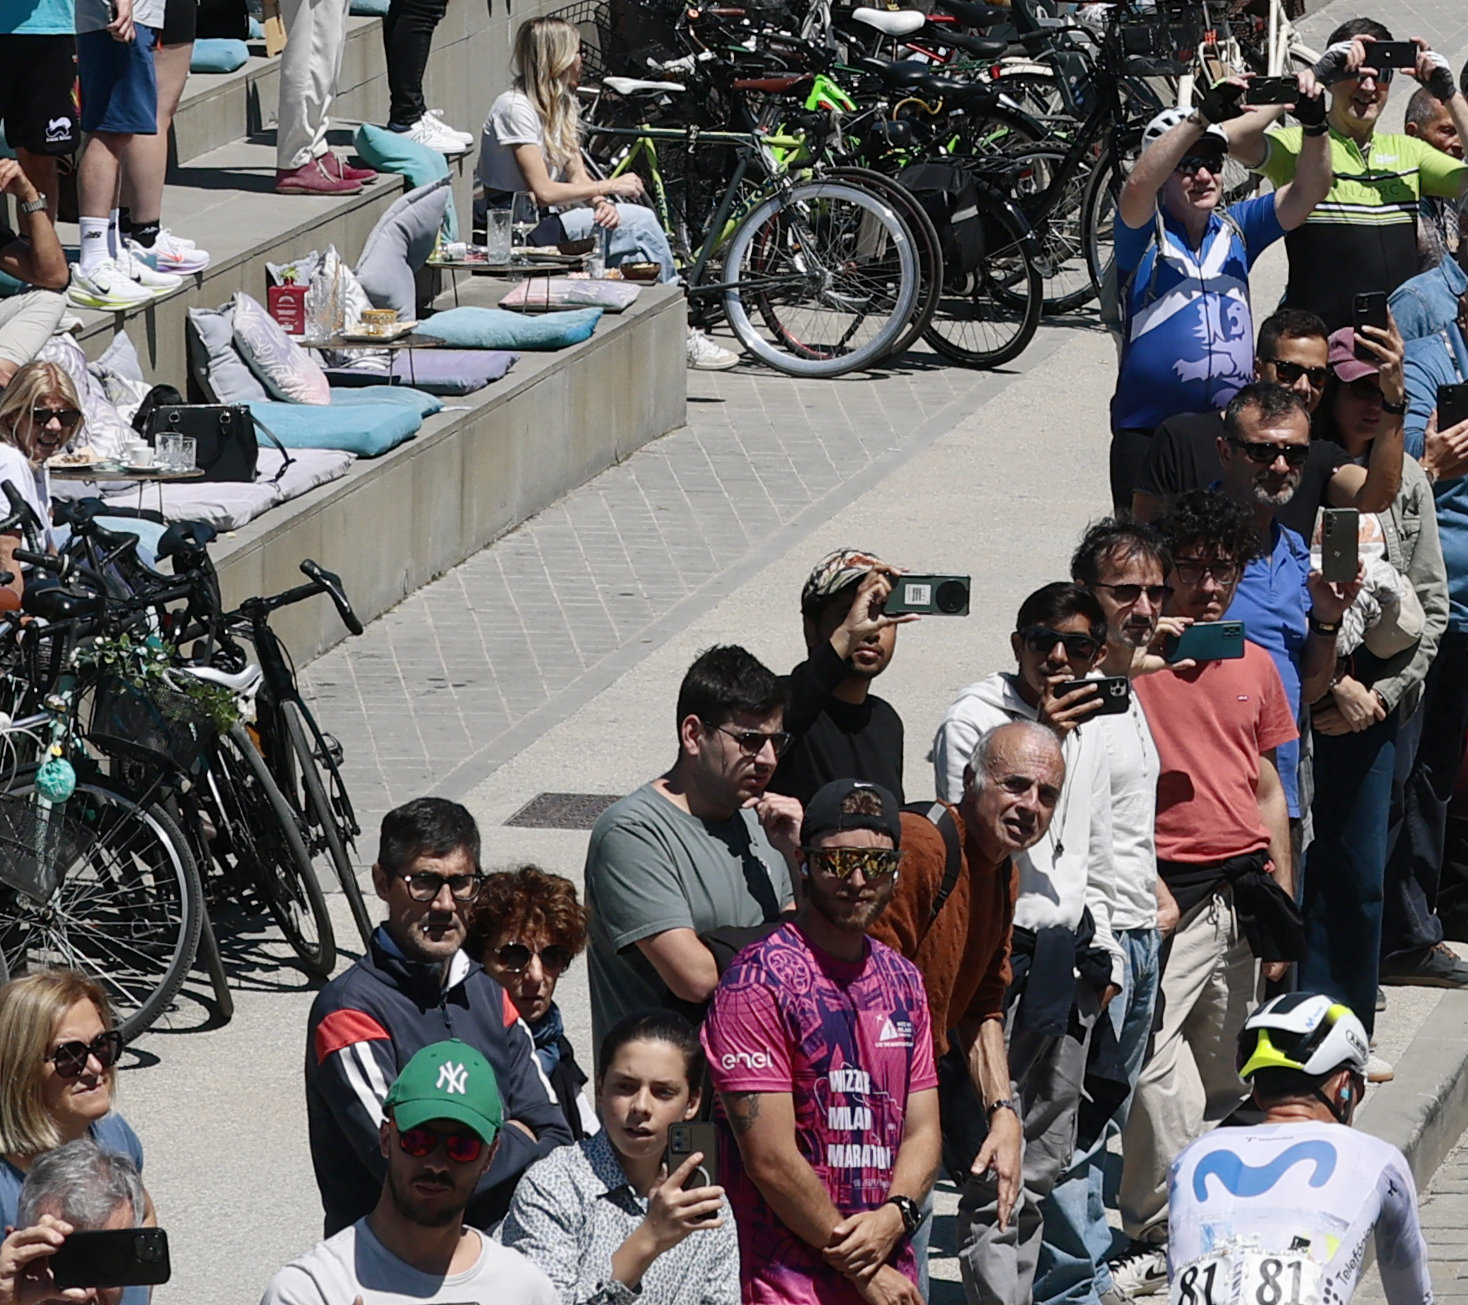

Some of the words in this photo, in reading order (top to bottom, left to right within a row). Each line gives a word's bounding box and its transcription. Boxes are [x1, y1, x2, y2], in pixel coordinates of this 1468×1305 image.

[721, 1048, 774, 1070] enel
[1178, 1263, 1217, 1305] 81
[1255, 1257, 1303, 1305] 81
